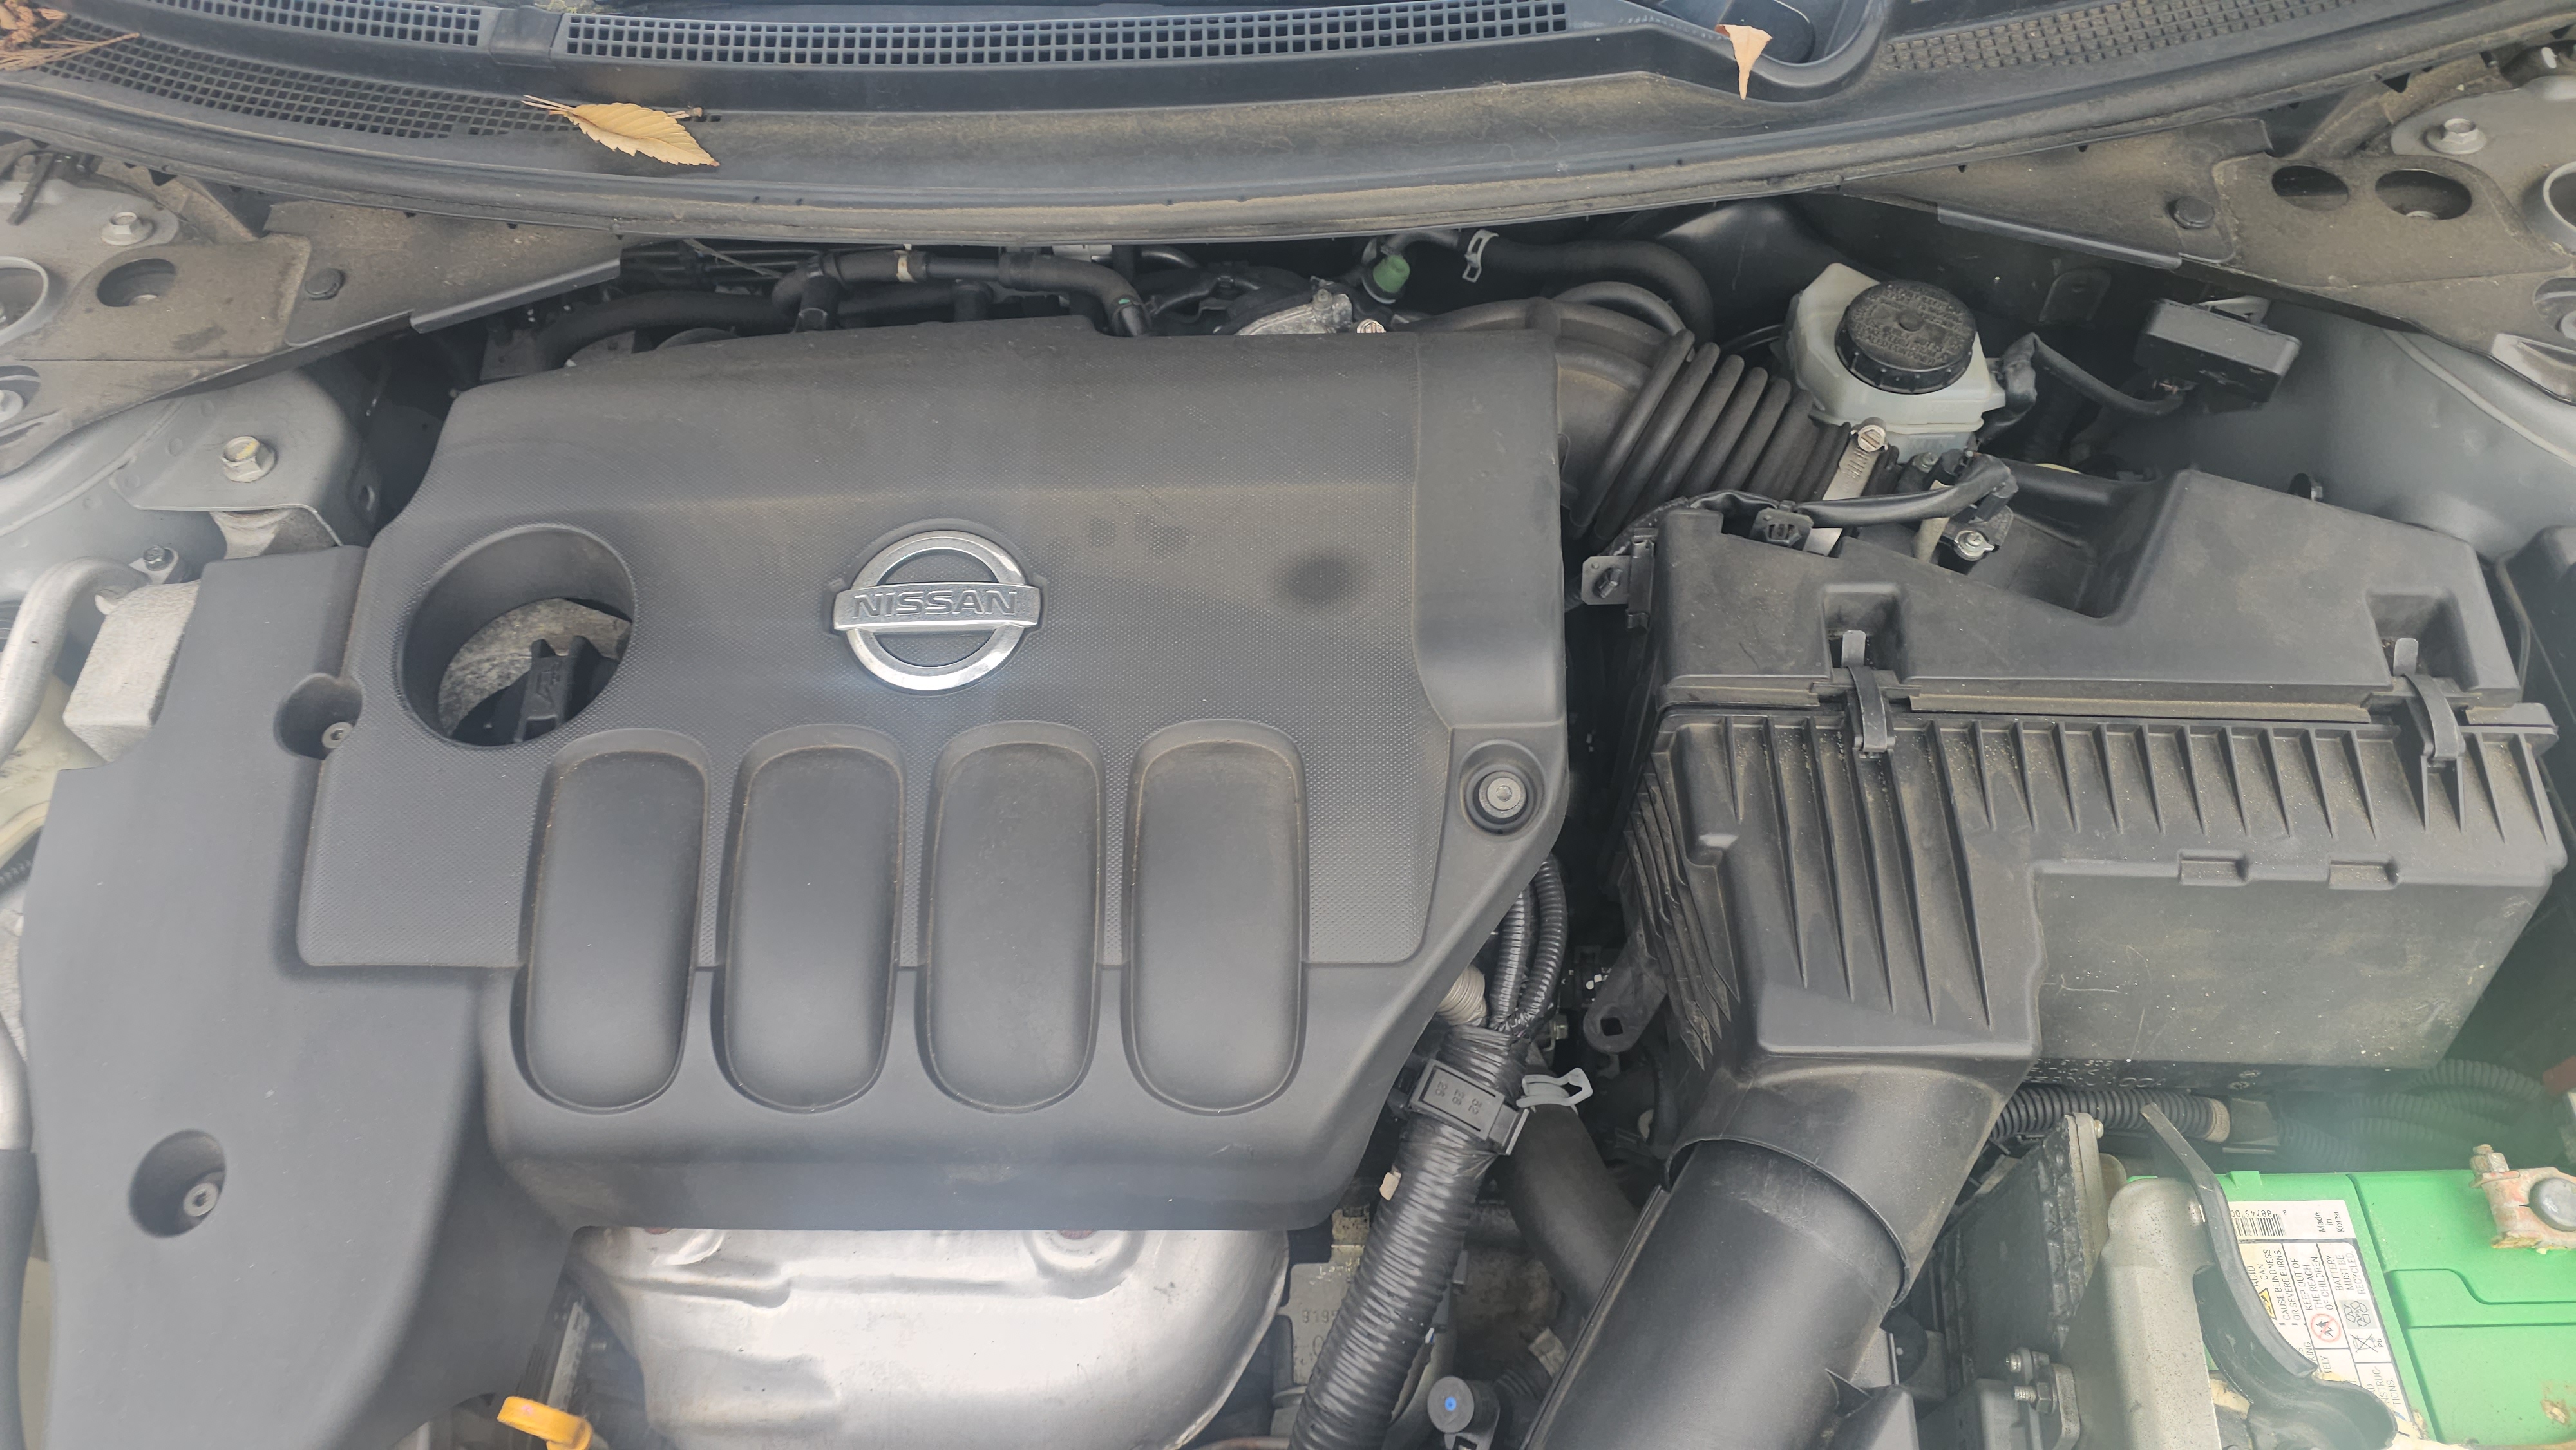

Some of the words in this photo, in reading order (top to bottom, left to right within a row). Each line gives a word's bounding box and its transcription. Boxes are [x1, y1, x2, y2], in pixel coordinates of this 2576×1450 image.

[852, 590, 1018, 619] NISSAN
[2315, 1212, 2326, 1232] Made
[2334, 1212, 2345, 1232] Korea
[2290, 1257, 2301, 1269] OF
[2335, 1254, 2344, 1266] BE
[2257, 1263, 2268, 1280] CAN
[2263, 1249, 2283, 1292] BLINDNESS
[2294, 1271, 2305, 1288] OUT
[2302, 1264, 2317, 1293] REACH
[2325, 1255, 2344, 1291] BATTERY
[2341, 1269, 2354, 1290] MUST
[2345, 1251, 2367, 1295] RECYCLED.
[2284, 1277, 2299, 1308] SEVERE
[2300, 1290, 2313, 1310] KEEP
[2312, 1295, 2324, 1310] THE
[2278, 1295, 2291, 1321] CAUSE
[2293, 1308, 2302, 1321] OR
[2322, 1299, 2334, 1310] OF
[2305, 1342, 2316, 1361] KING
[2377, 1338, 2384, 1348] Pb
[2372, 1366, 2389, 1404] NSTRUC-
[2386, 1377, 2401, 1406] TIONS.
